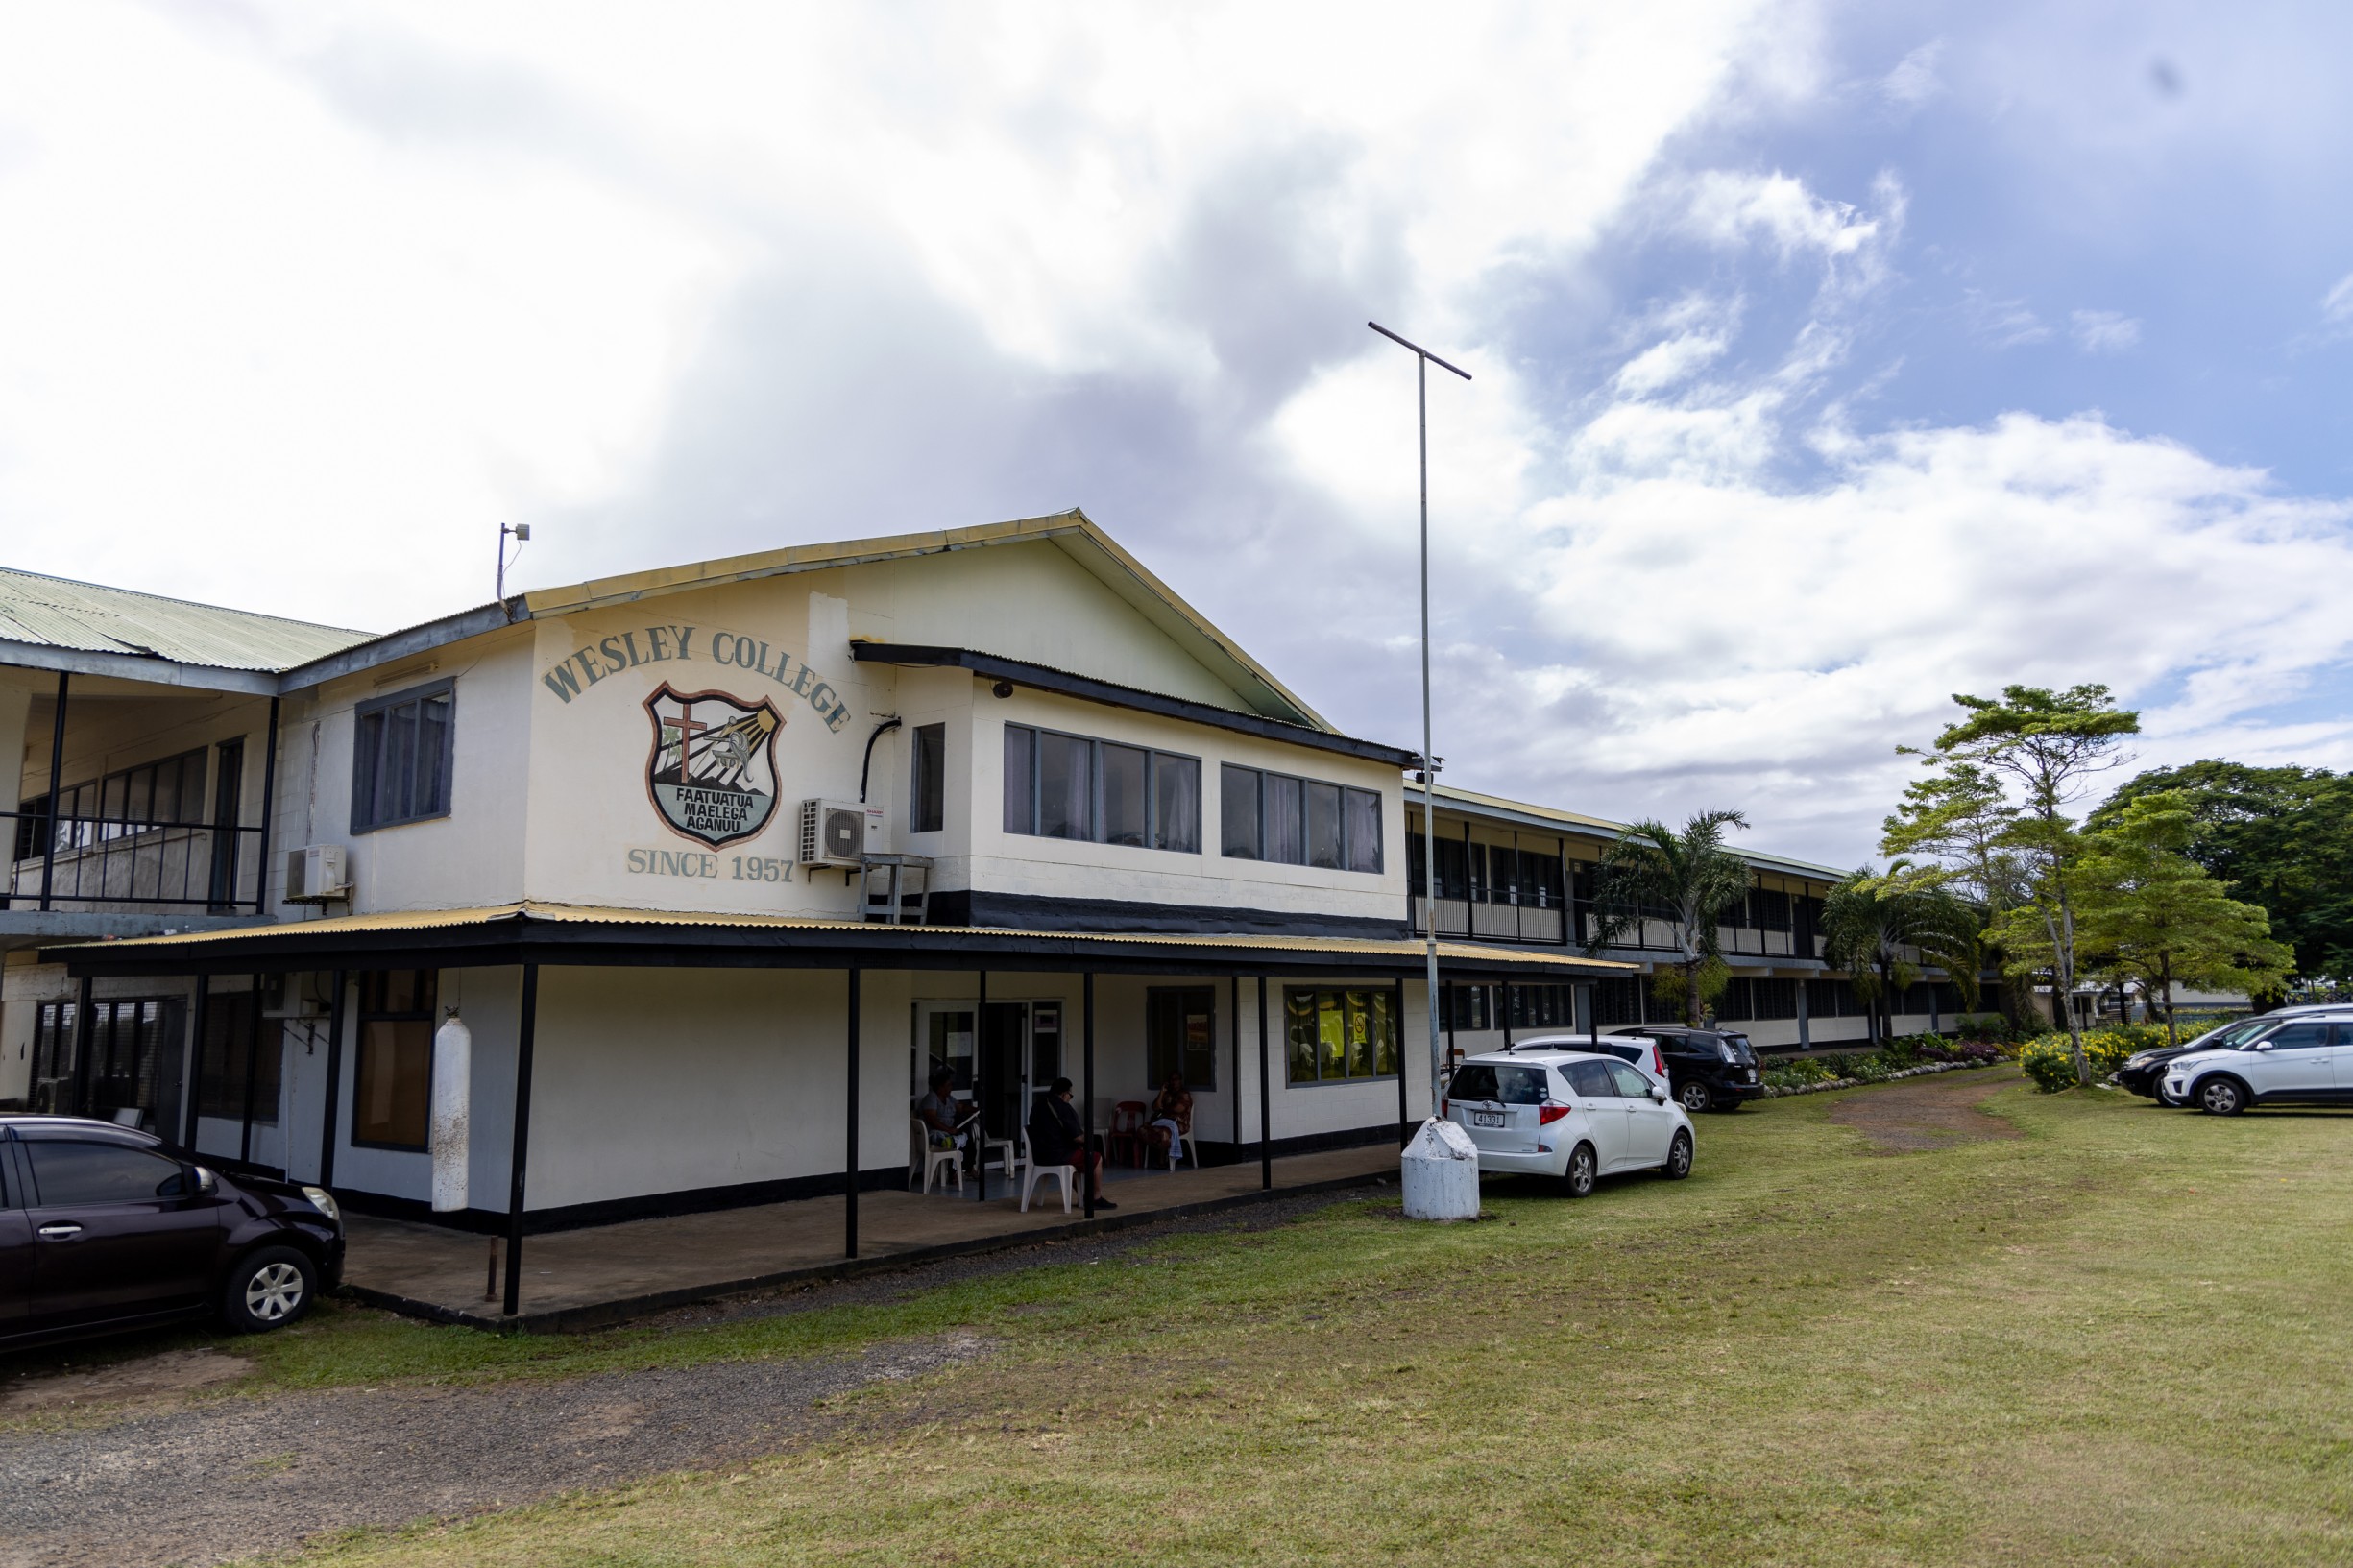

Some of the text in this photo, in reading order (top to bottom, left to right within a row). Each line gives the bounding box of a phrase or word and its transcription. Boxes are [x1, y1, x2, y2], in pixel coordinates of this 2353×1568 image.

[541, 625, 852, 735] WESLEY COLLEGE
[676, 788, 754, 808] FAATUATUA
[684, 803, 748, 821] MAELEGA
[686, 816, 740, 832] AGANUU
[628, 848, 794, 882] SINCE 1957
[1478, 1115, 1499, 1124] 41331
